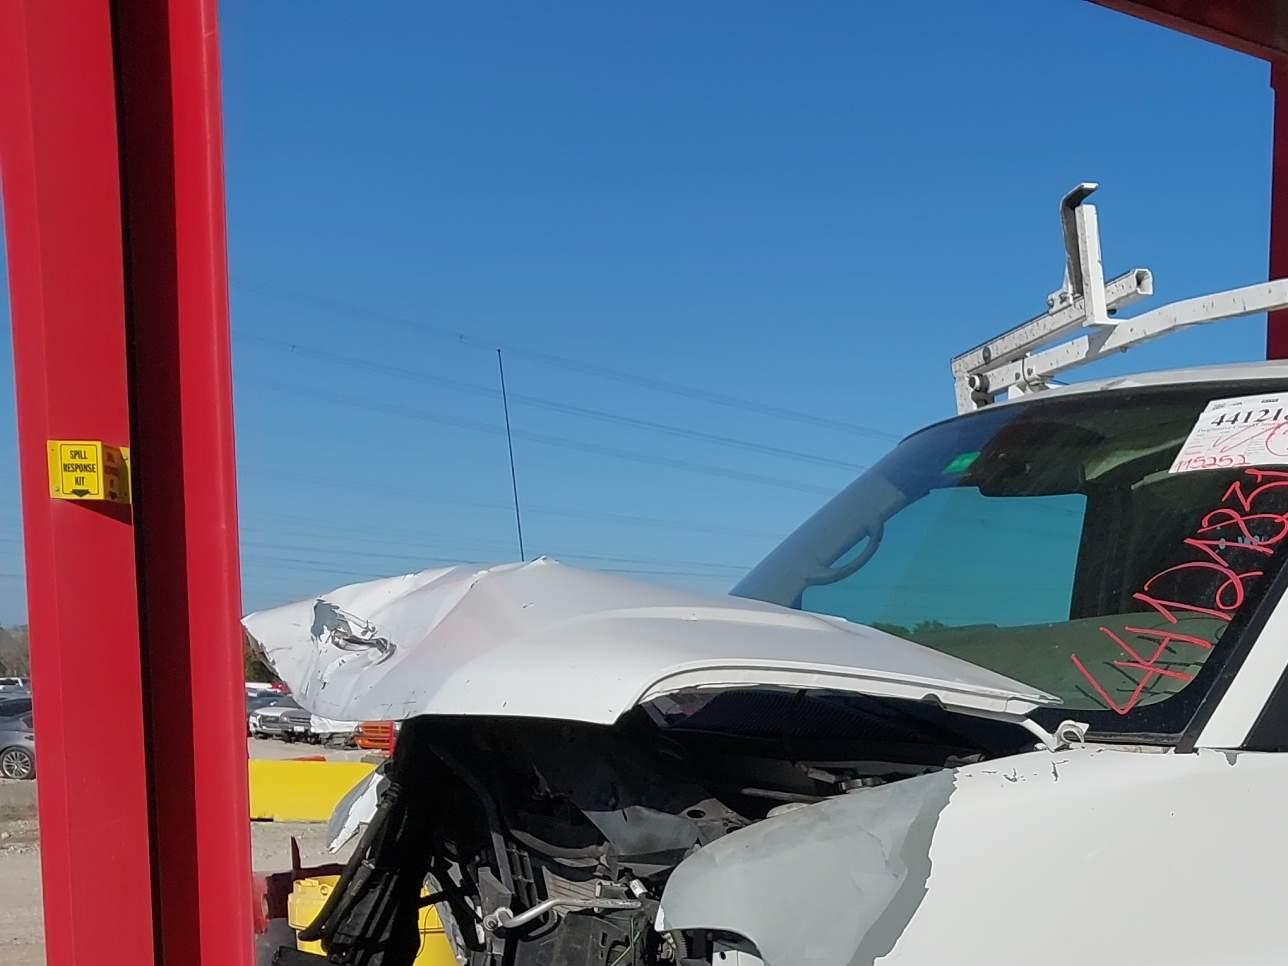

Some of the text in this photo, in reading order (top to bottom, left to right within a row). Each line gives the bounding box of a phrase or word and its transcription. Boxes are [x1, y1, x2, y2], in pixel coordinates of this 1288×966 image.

[69, 449, 89, 460] SPILL
[63, 463, 97, 473] RESPONSE
[74, 476, 86, 486] KIT
